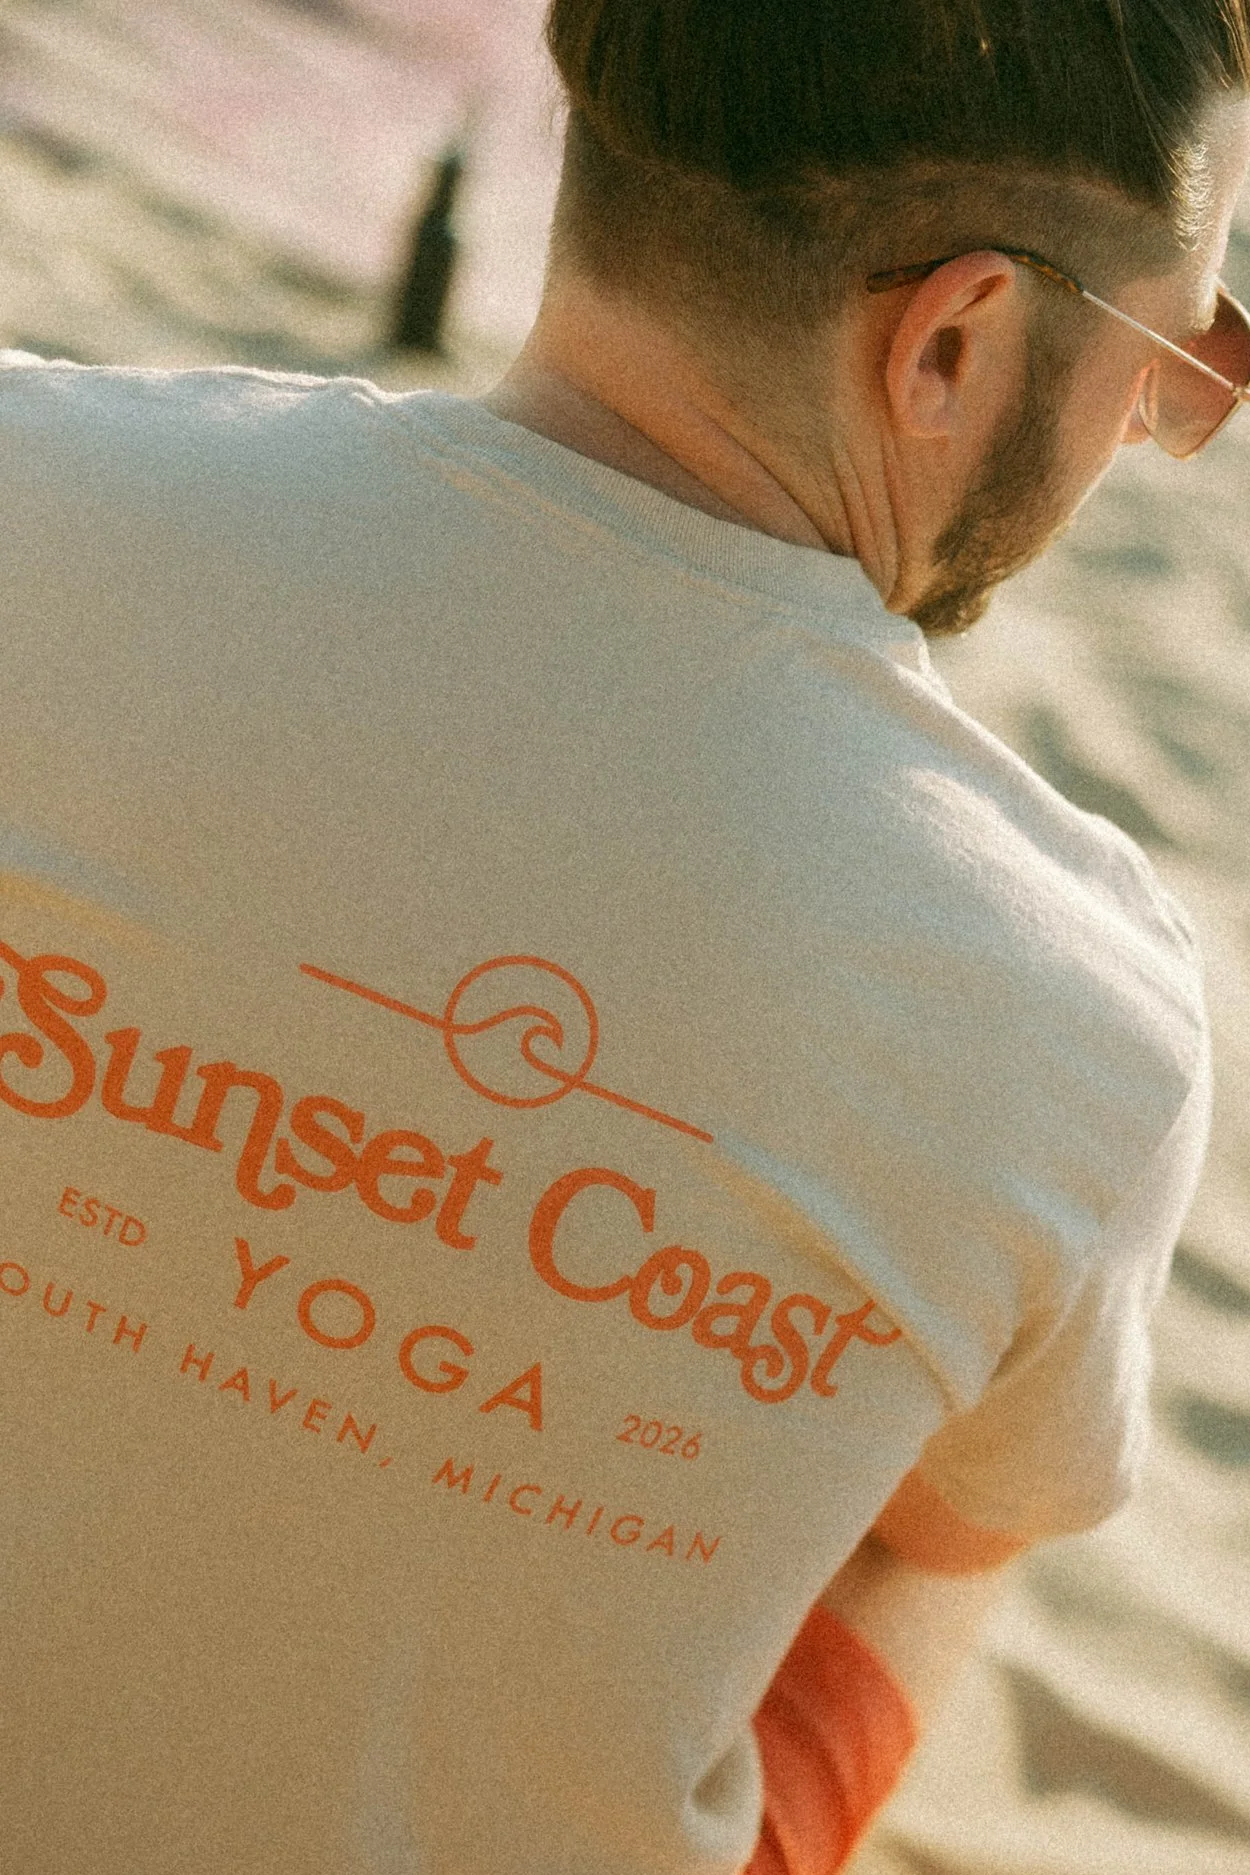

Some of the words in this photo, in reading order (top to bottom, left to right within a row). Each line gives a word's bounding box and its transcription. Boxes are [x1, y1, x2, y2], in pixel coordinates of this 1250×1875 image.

[0, 939, 504, 1250] Sunset
[528, 1167, 902, 1404] Coast
[57, 1186, 149, 1247] ESTD
[233, 1236, 544, 1432] YOGA
[615, 1414, 703, 1460] 2026
[179, 1344, 393, 1468] HAVEN,
[432, 1458, 722, 1565] MICHIGAN
